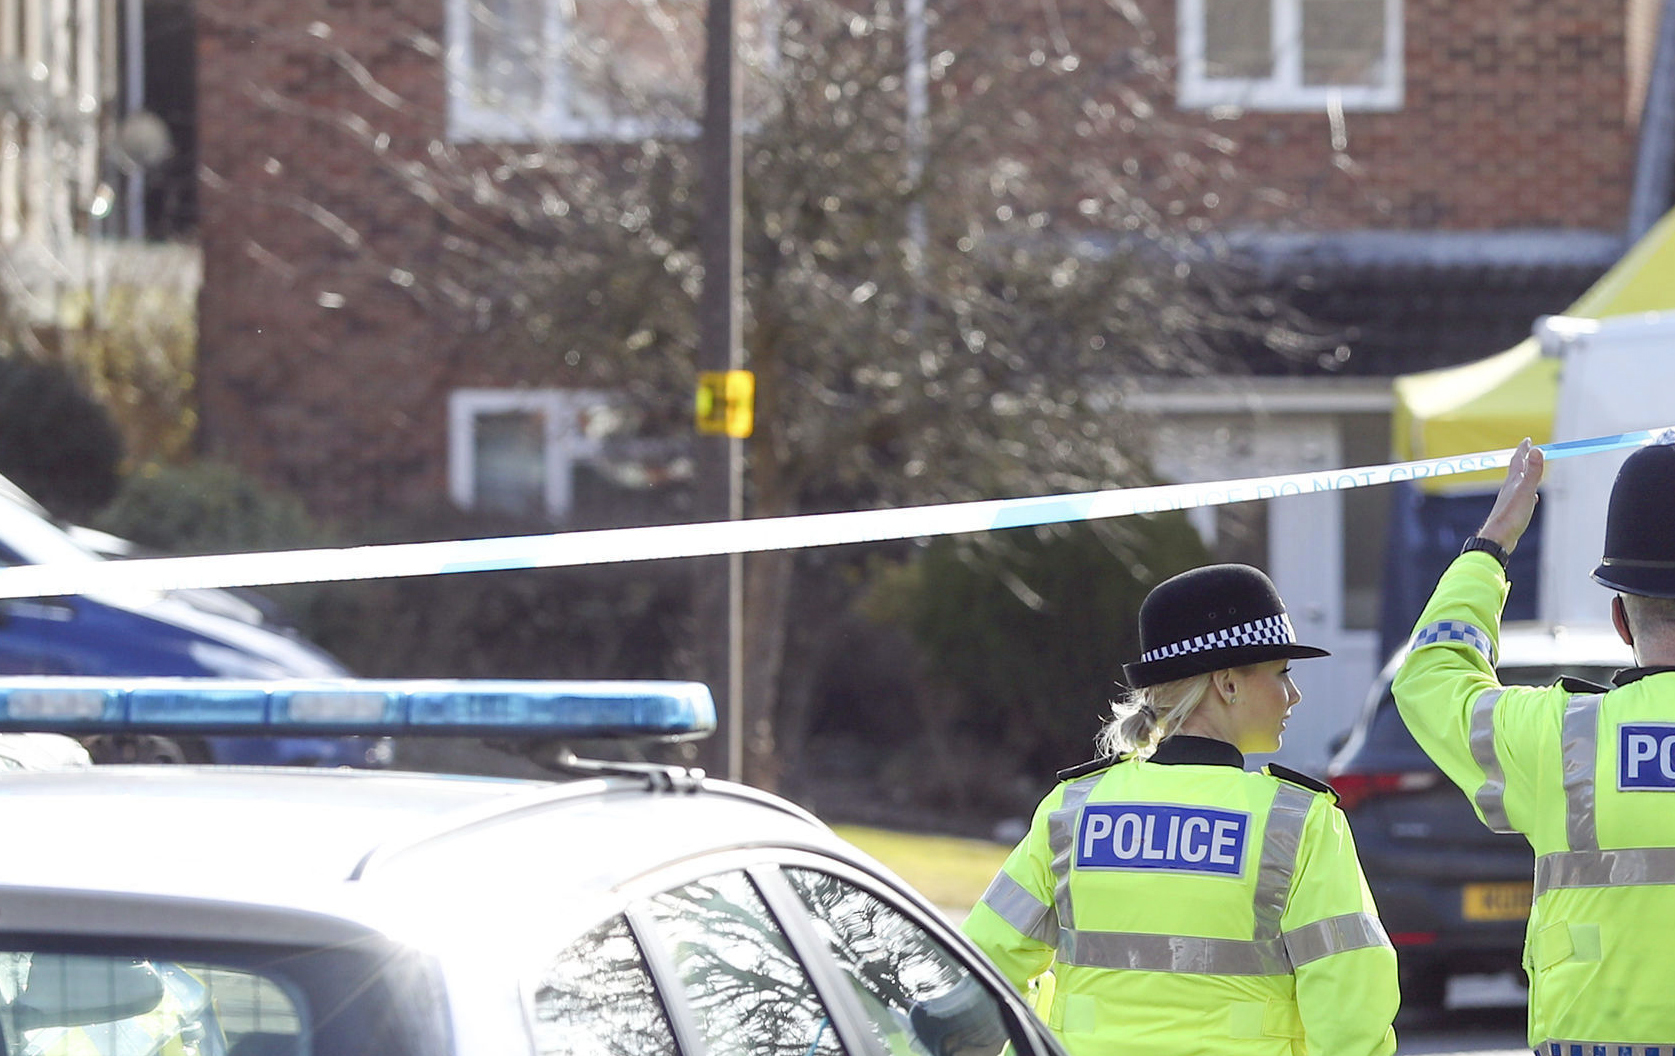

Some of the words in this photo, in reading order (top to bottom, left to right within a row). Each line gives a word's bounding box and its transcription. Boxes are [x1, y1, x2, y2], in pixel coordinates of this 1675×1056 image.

[1313, 471, 1376, 492] NOT
[1389, 455, 1498, 482] CROSS
[1083, 812, 1240, 865] POLICE
